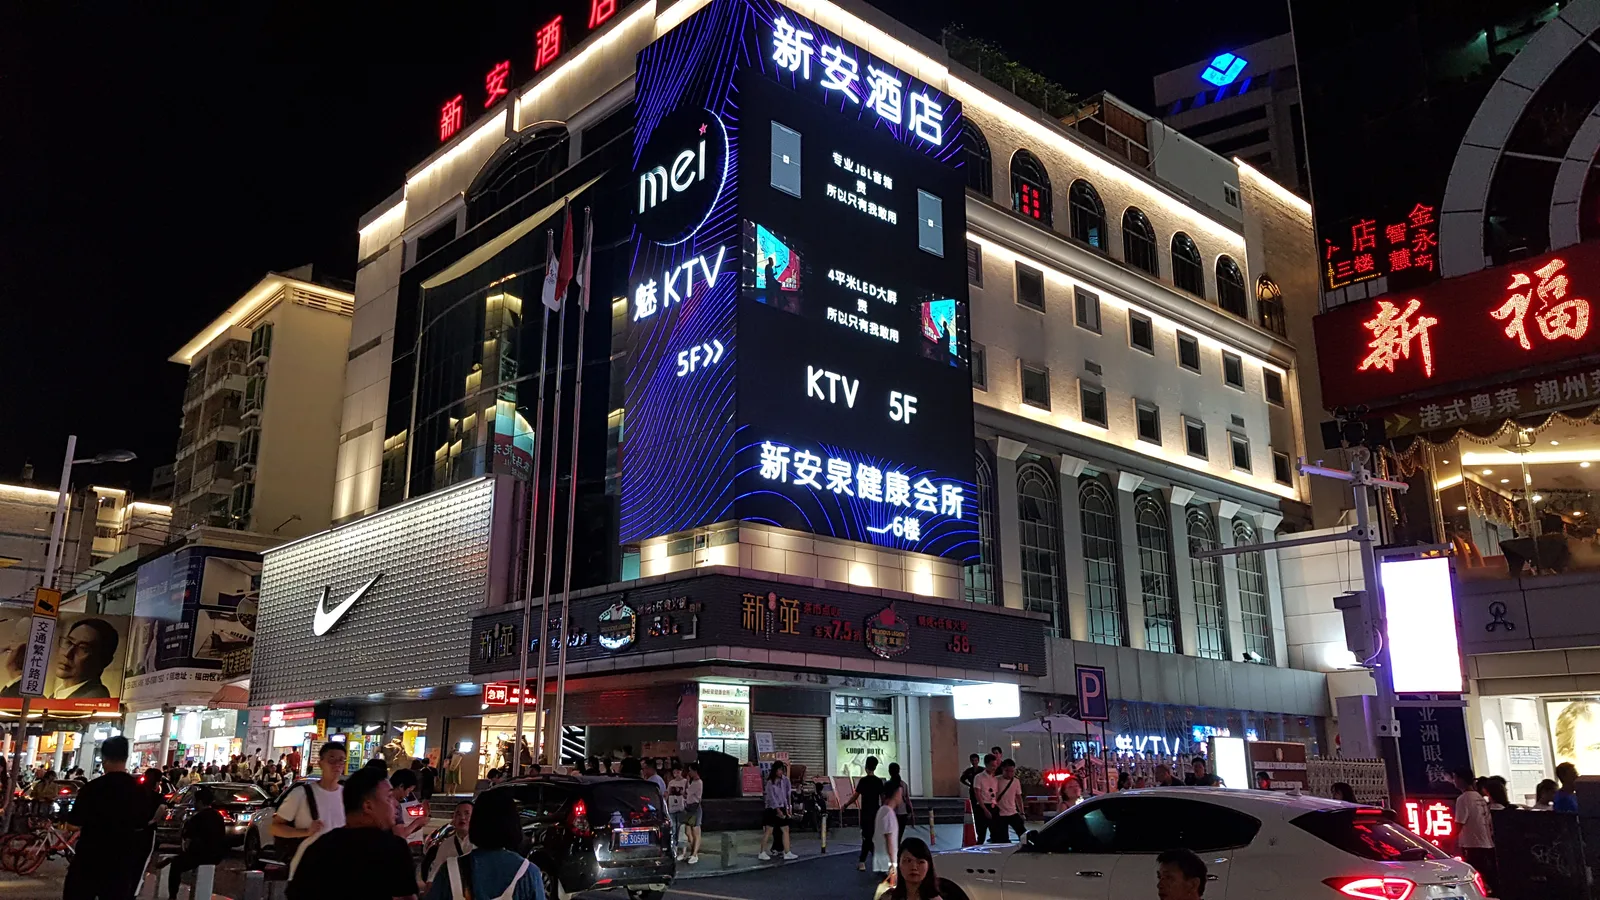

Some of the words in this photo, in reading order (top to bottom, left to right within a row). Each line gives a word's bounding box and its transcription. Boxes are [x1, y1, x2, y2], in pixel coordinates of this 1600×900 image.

[772, 16, 943, 146] 新安酒店
[639, 124, 706, 214] mei
[832, 151, 893, 190] 专业JBL音箱
[826, 183, 897, 225] 所以只有我敢用
[827, 269, 897, 305] 4平米LED大屏
[827, 306, 899, 343] 所以只有我敢用
[677, 345, 701, 377] 5F
[807, 365, 859, 408] KTV
[889, 391, 917, 424] 5F
[1418, 388, 1522, 428] 港式粤菜
[760, 440, 964, 519] 新安泉健康会所
[892, 516, 921, 541] 6楼
[26, 620, 48, 692] 交通繁忙路段
[1082, 672, 1101, 714] P
[840, 724, 890, 742] 新安酒店
[1417, 706, 1448, 784] 亚洲眼镜
